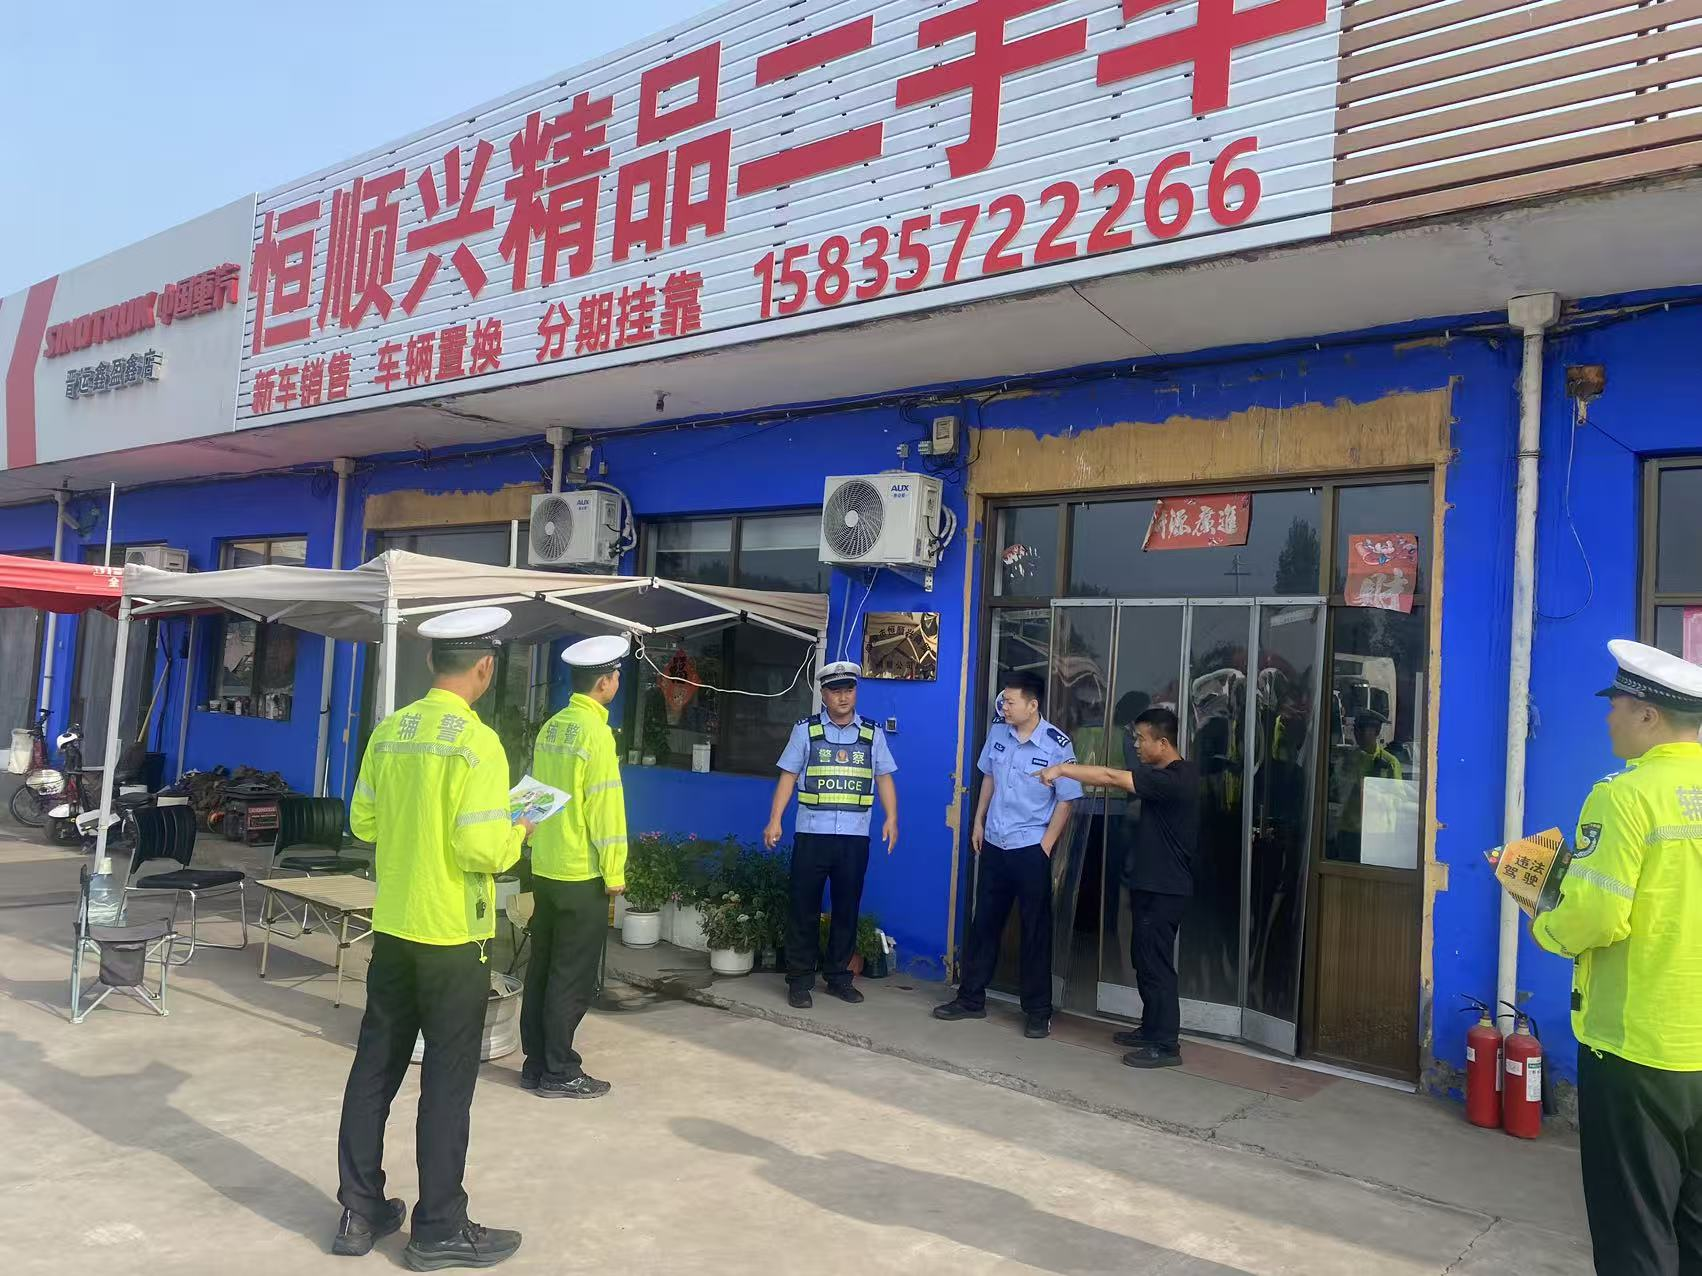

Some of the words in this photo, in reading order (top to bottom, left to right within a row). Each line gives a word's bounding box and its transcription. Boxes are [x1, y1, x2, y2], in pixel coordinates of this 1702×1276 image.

[249, 0, 1328, 356] 恒顺兴精品二手车
[752, 135, 1262, 320] 15835722266
[251, 350, 353, 414] 新车销售
[373, 316, 504, 392] 车辆置换
[536, 271, 702, 363] 分期挂靠
[891, 484, 909, 492] AUX
[398, 711, 469, 743] 辅警
[817, 778, 863, 792] POLICE
[1502, 864, 1539, 888] 驾驶
[1514, 854, 1546, 876] 违法
